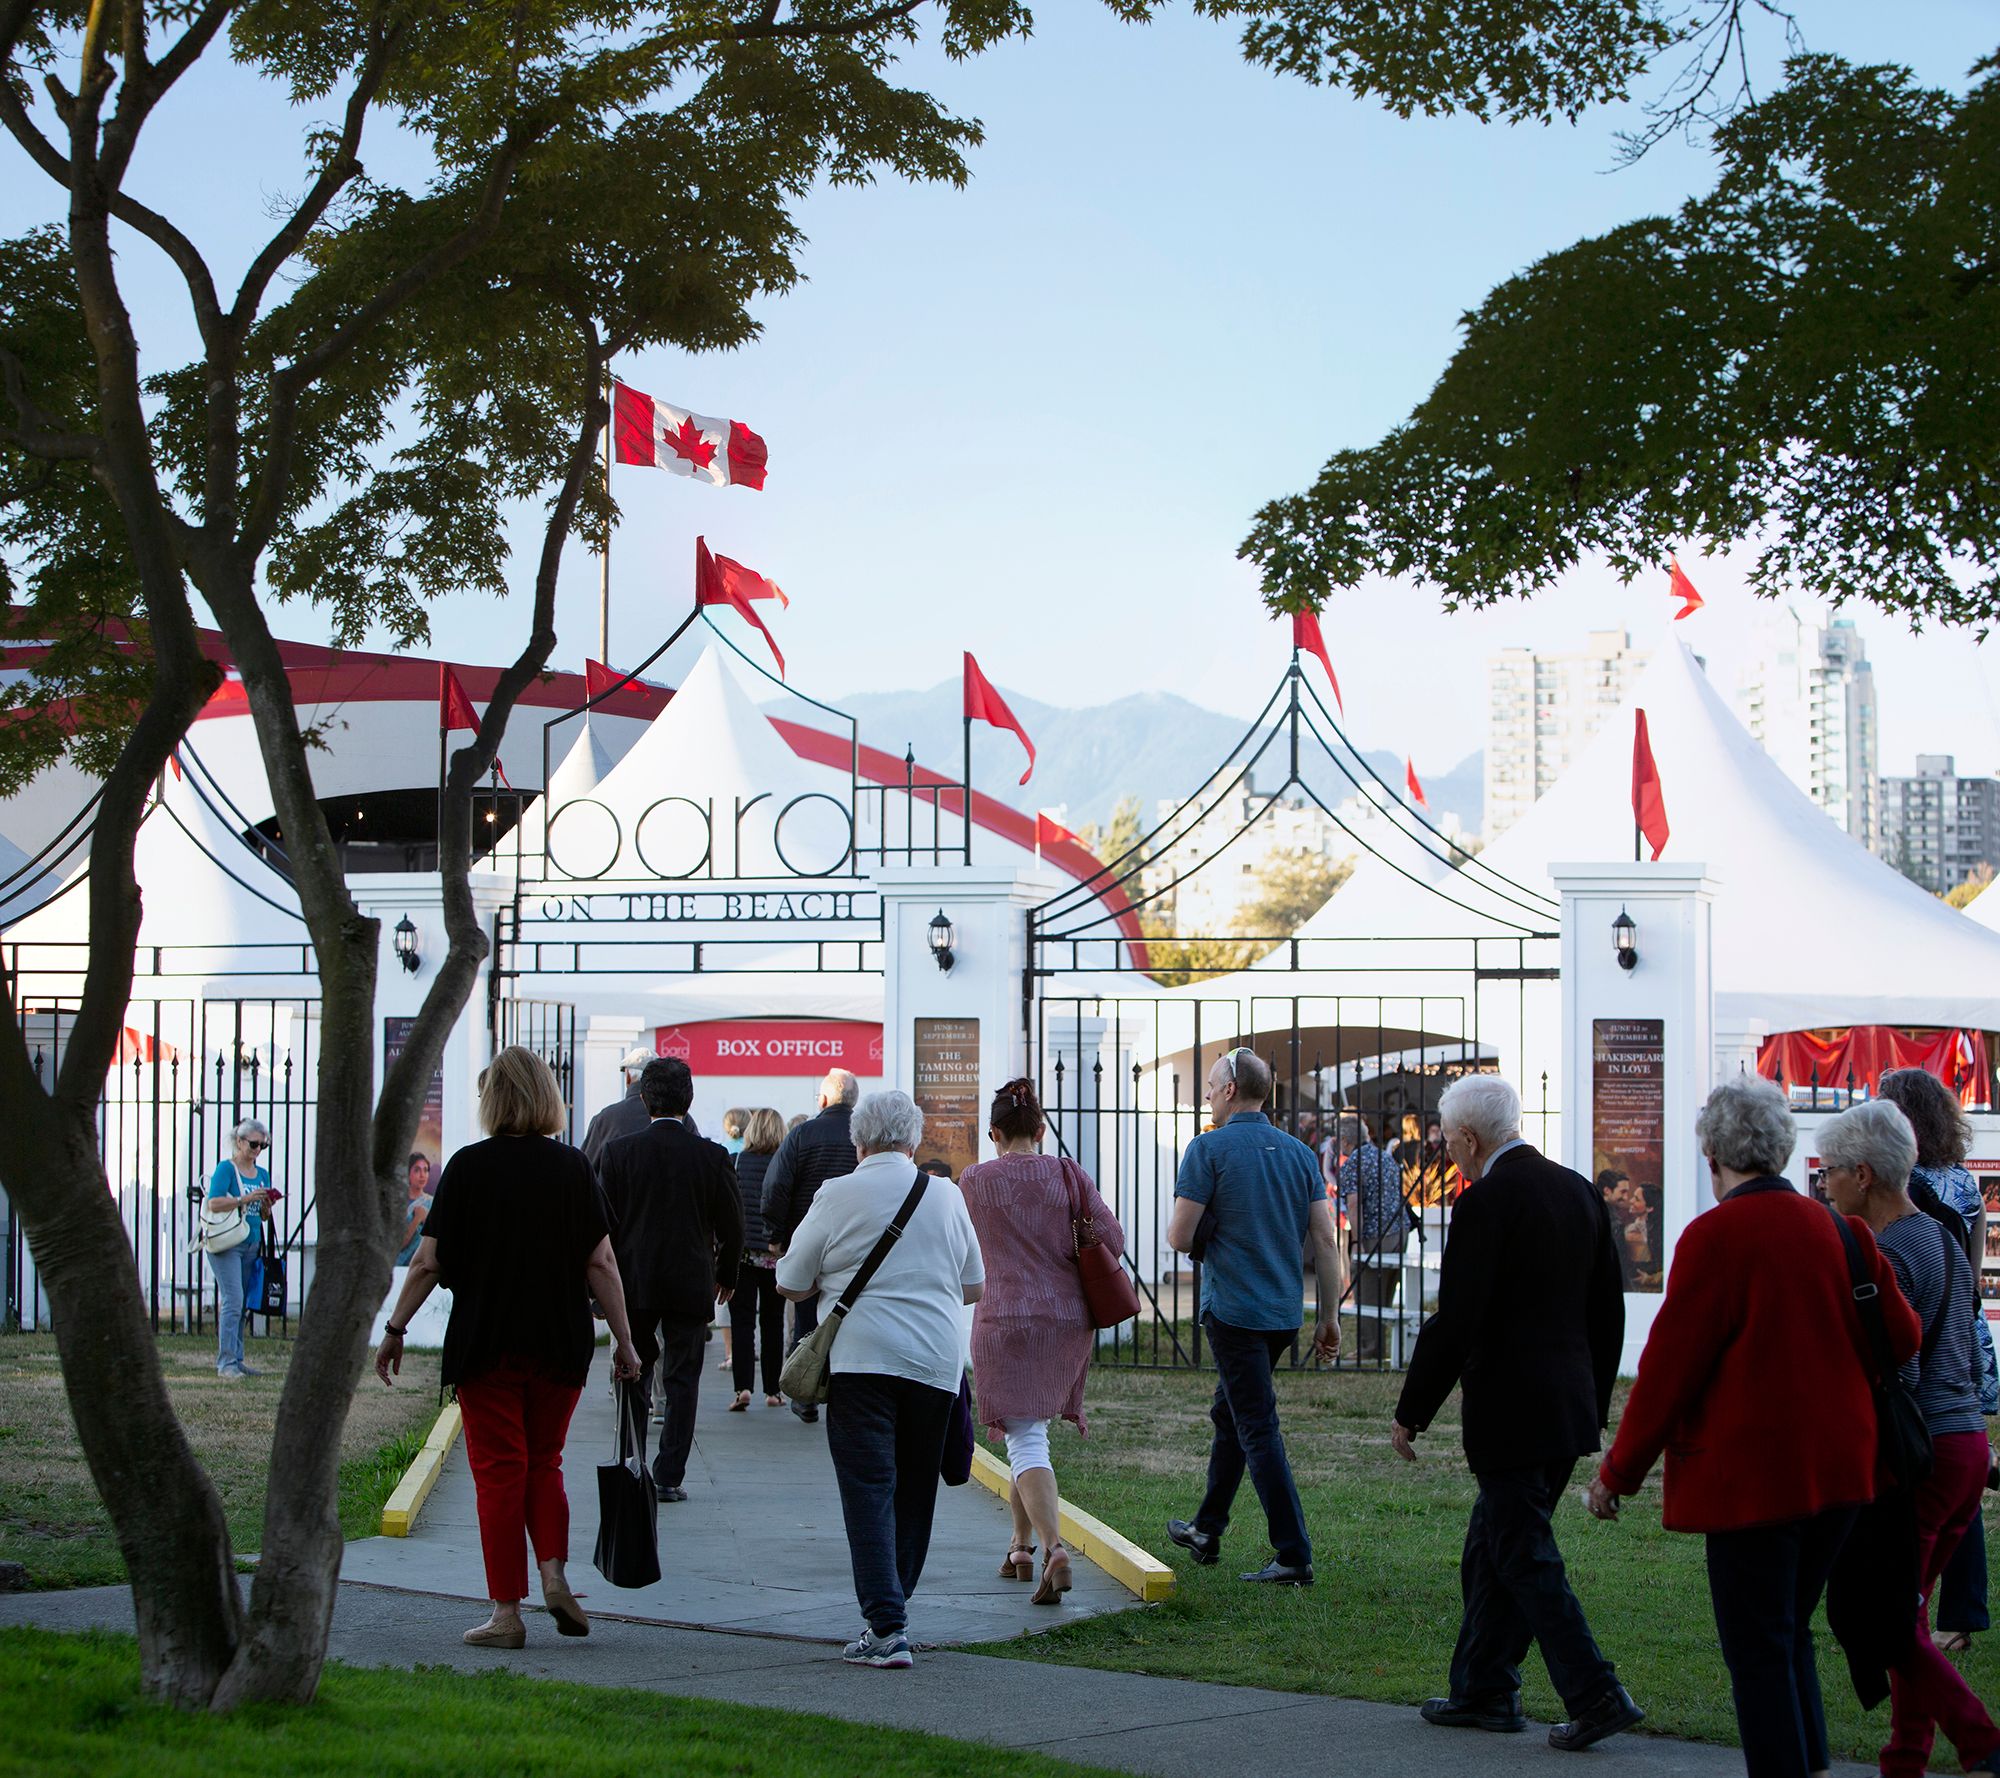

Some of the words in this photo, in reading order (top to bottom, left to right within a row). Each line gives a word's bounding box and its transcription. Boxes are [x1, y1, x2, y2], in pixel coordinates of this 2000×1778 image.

[542, 894, 593, 920] ON
[619, 894, 697, 920] THE
[724, 893, 854, 919] BEACH
[716, 1040, 760, 1056] BOX
[766, 1040, 843, 1056] OFFICE
[938, 1052, 961, 1060] THE
[918, 1062, 962, 1071] TAMING
[1608, 1064, 1620, 1074] IN
[1621, 1064, 1651, 1074] LOVE
[917, 1074, 940, 1082] THE
[943, 1073, 979, 1083] SHREW
